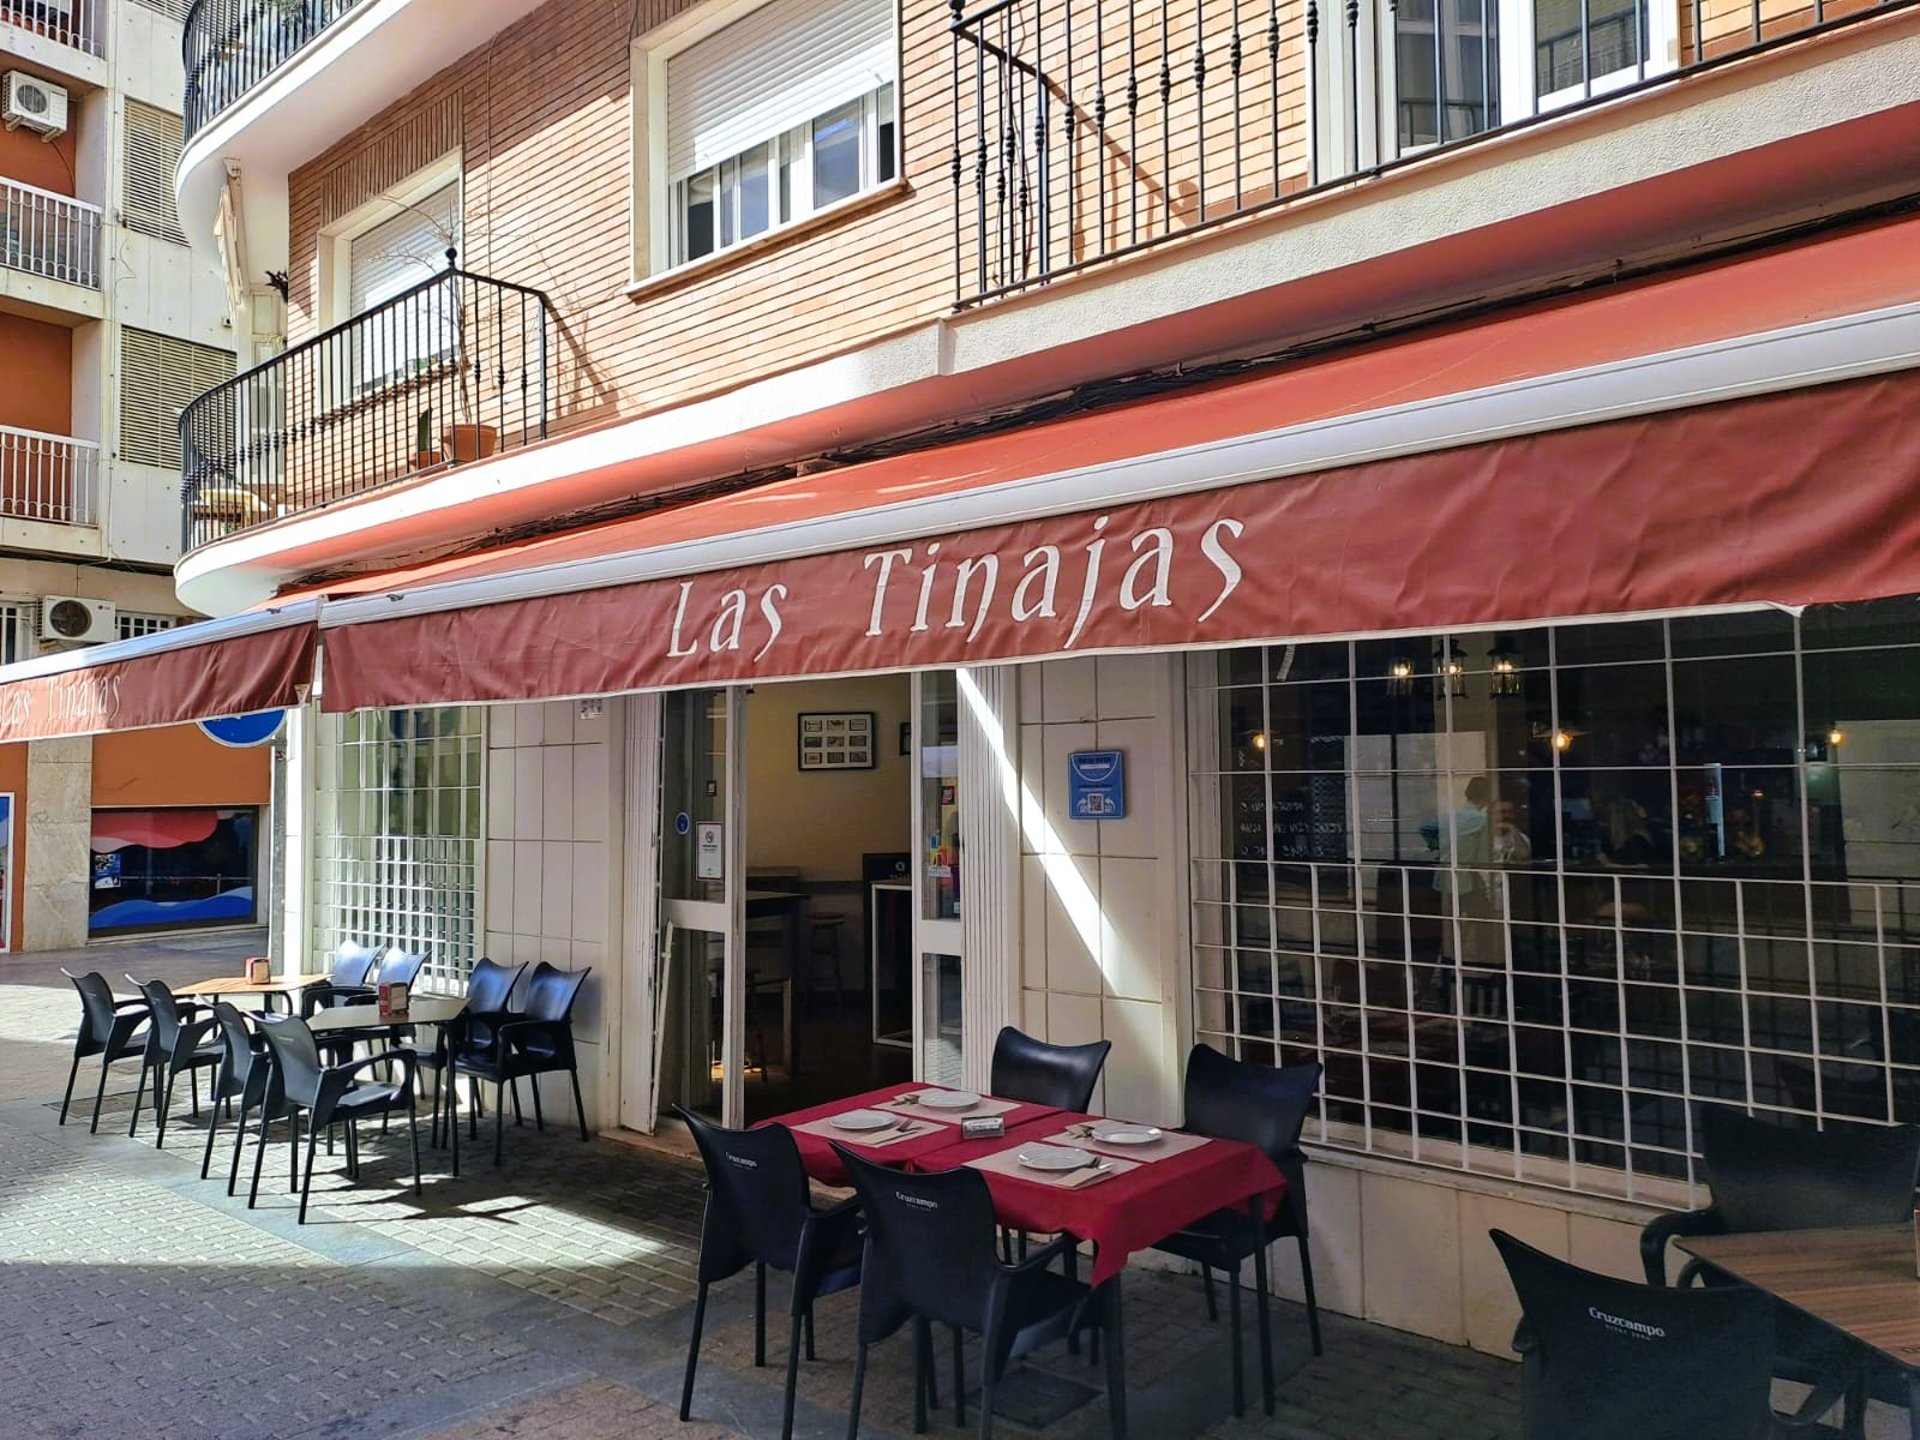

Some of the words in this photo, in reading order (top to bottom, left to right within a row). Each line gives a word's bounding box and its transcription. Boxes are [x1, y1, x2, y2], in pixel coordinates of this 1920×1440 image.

[666, 581, 788, 662] Las
[863, 515, 1245, 650] Tinajas
[1, 685, 30, 729] Las
[48, 675, 121, 732] Tinajas
[1588, 1306, 1666, 1337] Cruzcampo
